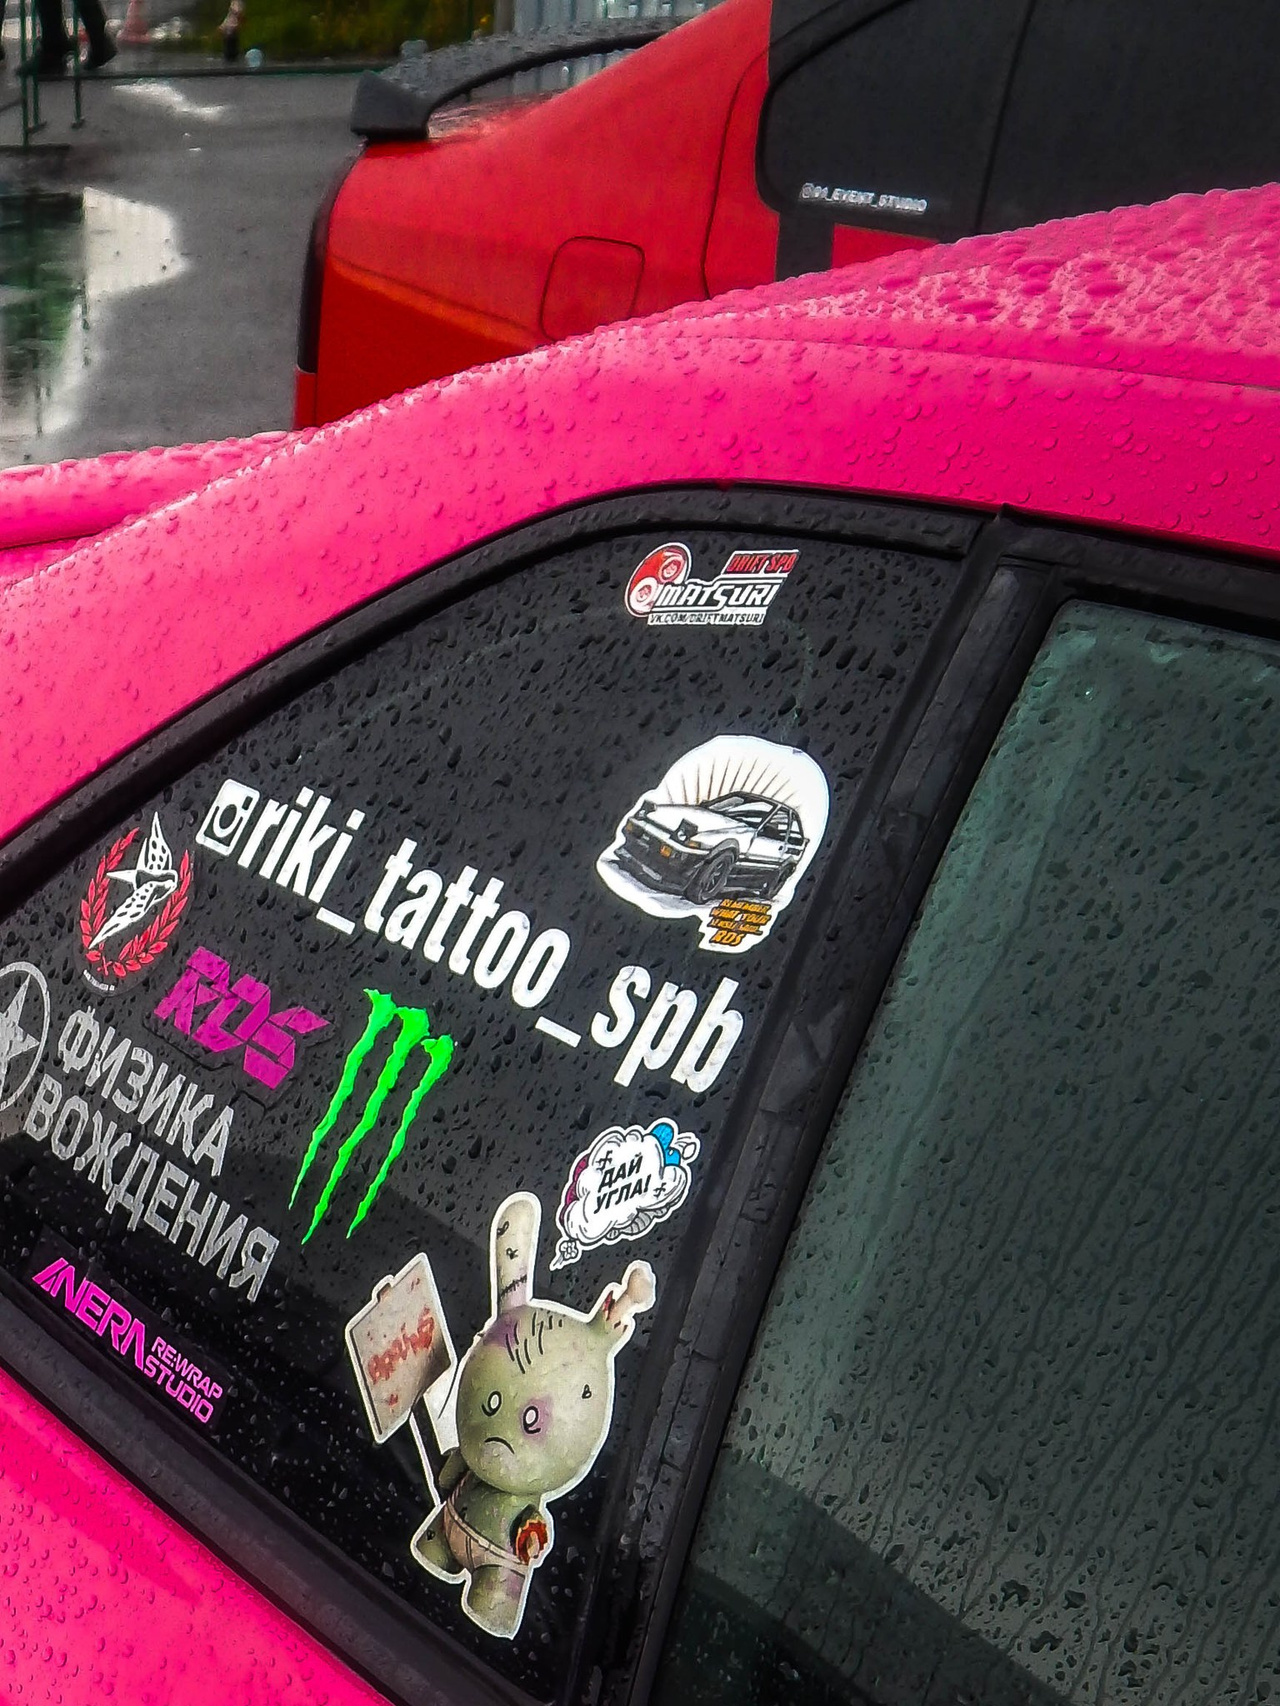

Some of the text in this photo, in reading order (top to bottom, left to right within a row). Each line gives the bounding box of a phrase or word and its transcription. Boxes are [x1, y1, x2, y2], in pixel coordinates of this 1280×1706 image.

[726, 553, 767, 572] DRIFT
[655, 584, 780, 607] MATSURI
[710, 930, 747, 946] RDS
[58, 1005, 235, 1177] ФИЗИКА
[22, 1073, 280, 1303] ВОЖДЕНИЯ
[598, 1152, 643, 1193] ДАЙ
[593, 1173, 652, 1214] УГЛА!
[151, 1336, 223, 1399] RE:WRAP
[144, 1355, 214, 1424] STUDIO
